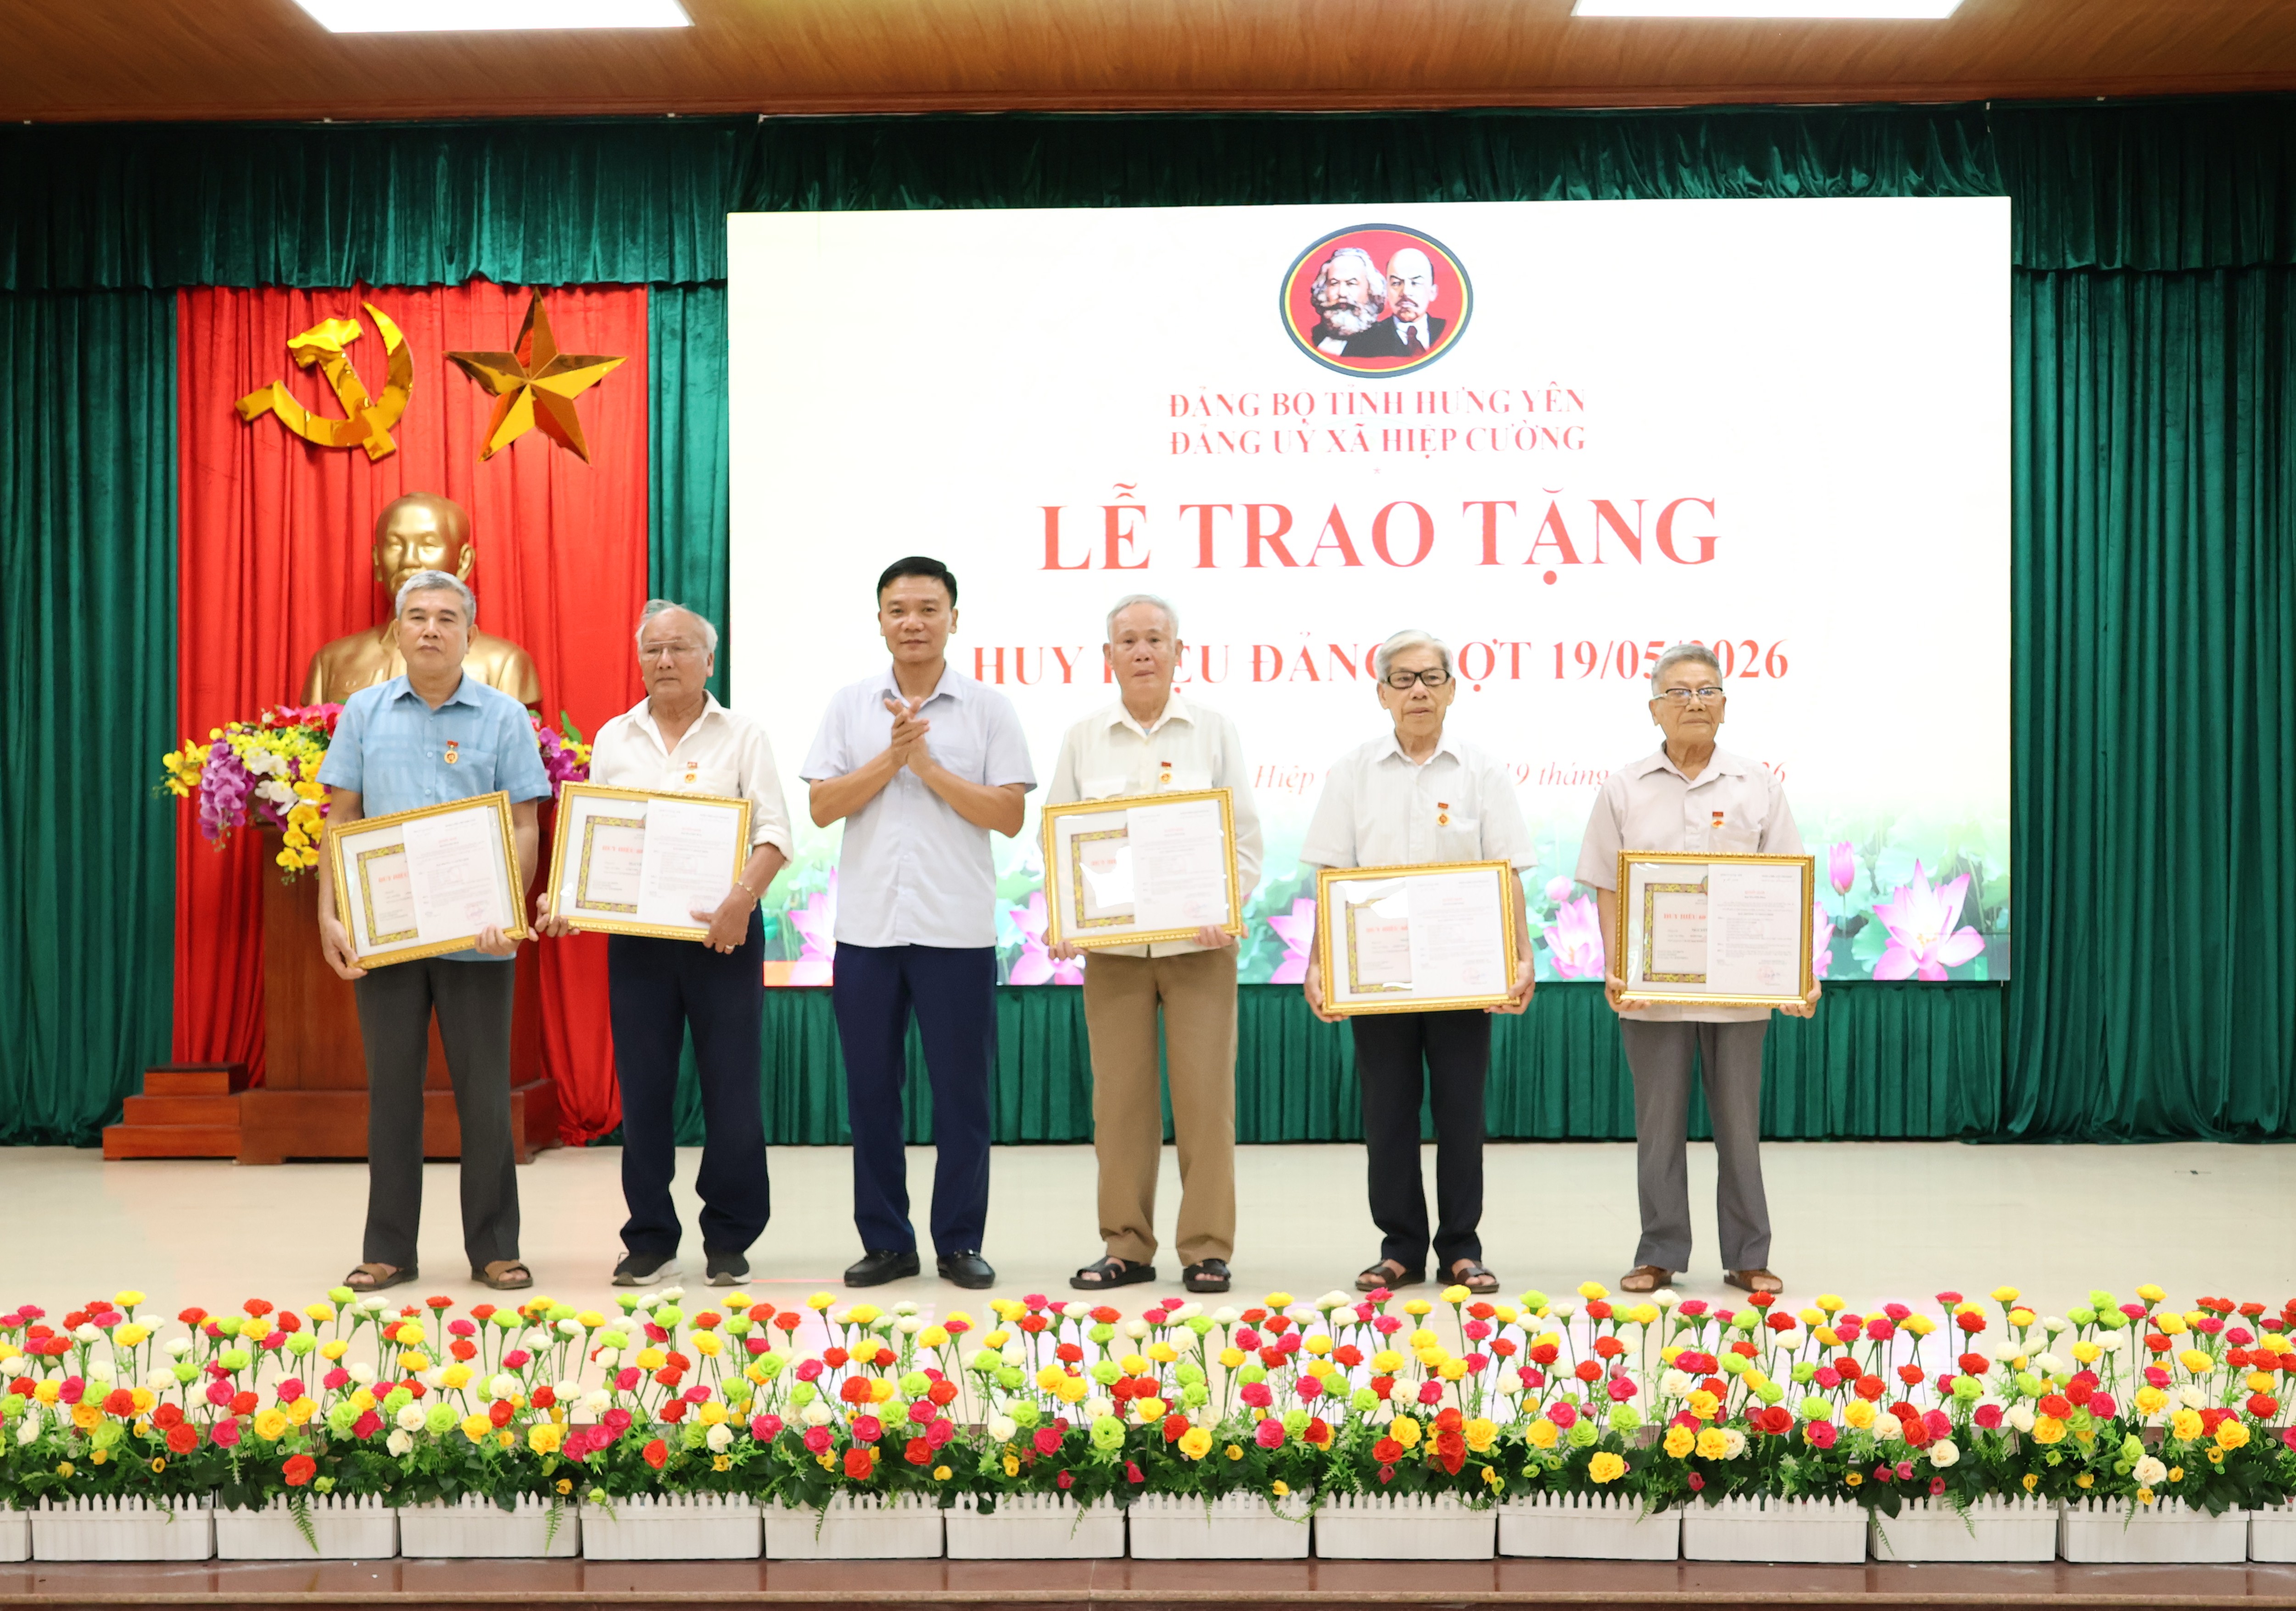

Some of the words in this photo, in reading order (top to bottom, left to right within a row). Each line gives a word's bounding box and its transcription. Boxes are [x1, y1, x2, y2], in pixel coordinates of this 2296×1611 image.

[1169, 387, 1260, 417] ĐẢNG
[1272, 388, 1316, 422] BỘ
[1416, 387, 1510, 414] HƯNG
[1521, 381, 1585, 413] YÊN
[1170, 423, 1261, 455] ĐẢNG
[1326, 423, 1370, 453] XÃ
[1382, 425, 1458, 459] HIỆP
[1465, 420, 1585, 452] CƯỜNG
[1037, 483, 1151, 570] LỄ
[1179, 500, 1435, 569] TRAO
[1462, 487, 1722, 585] TẶNG
[972, 646, 1084, 685] HUY
[1450, 638, 1531, 693] ỢT
